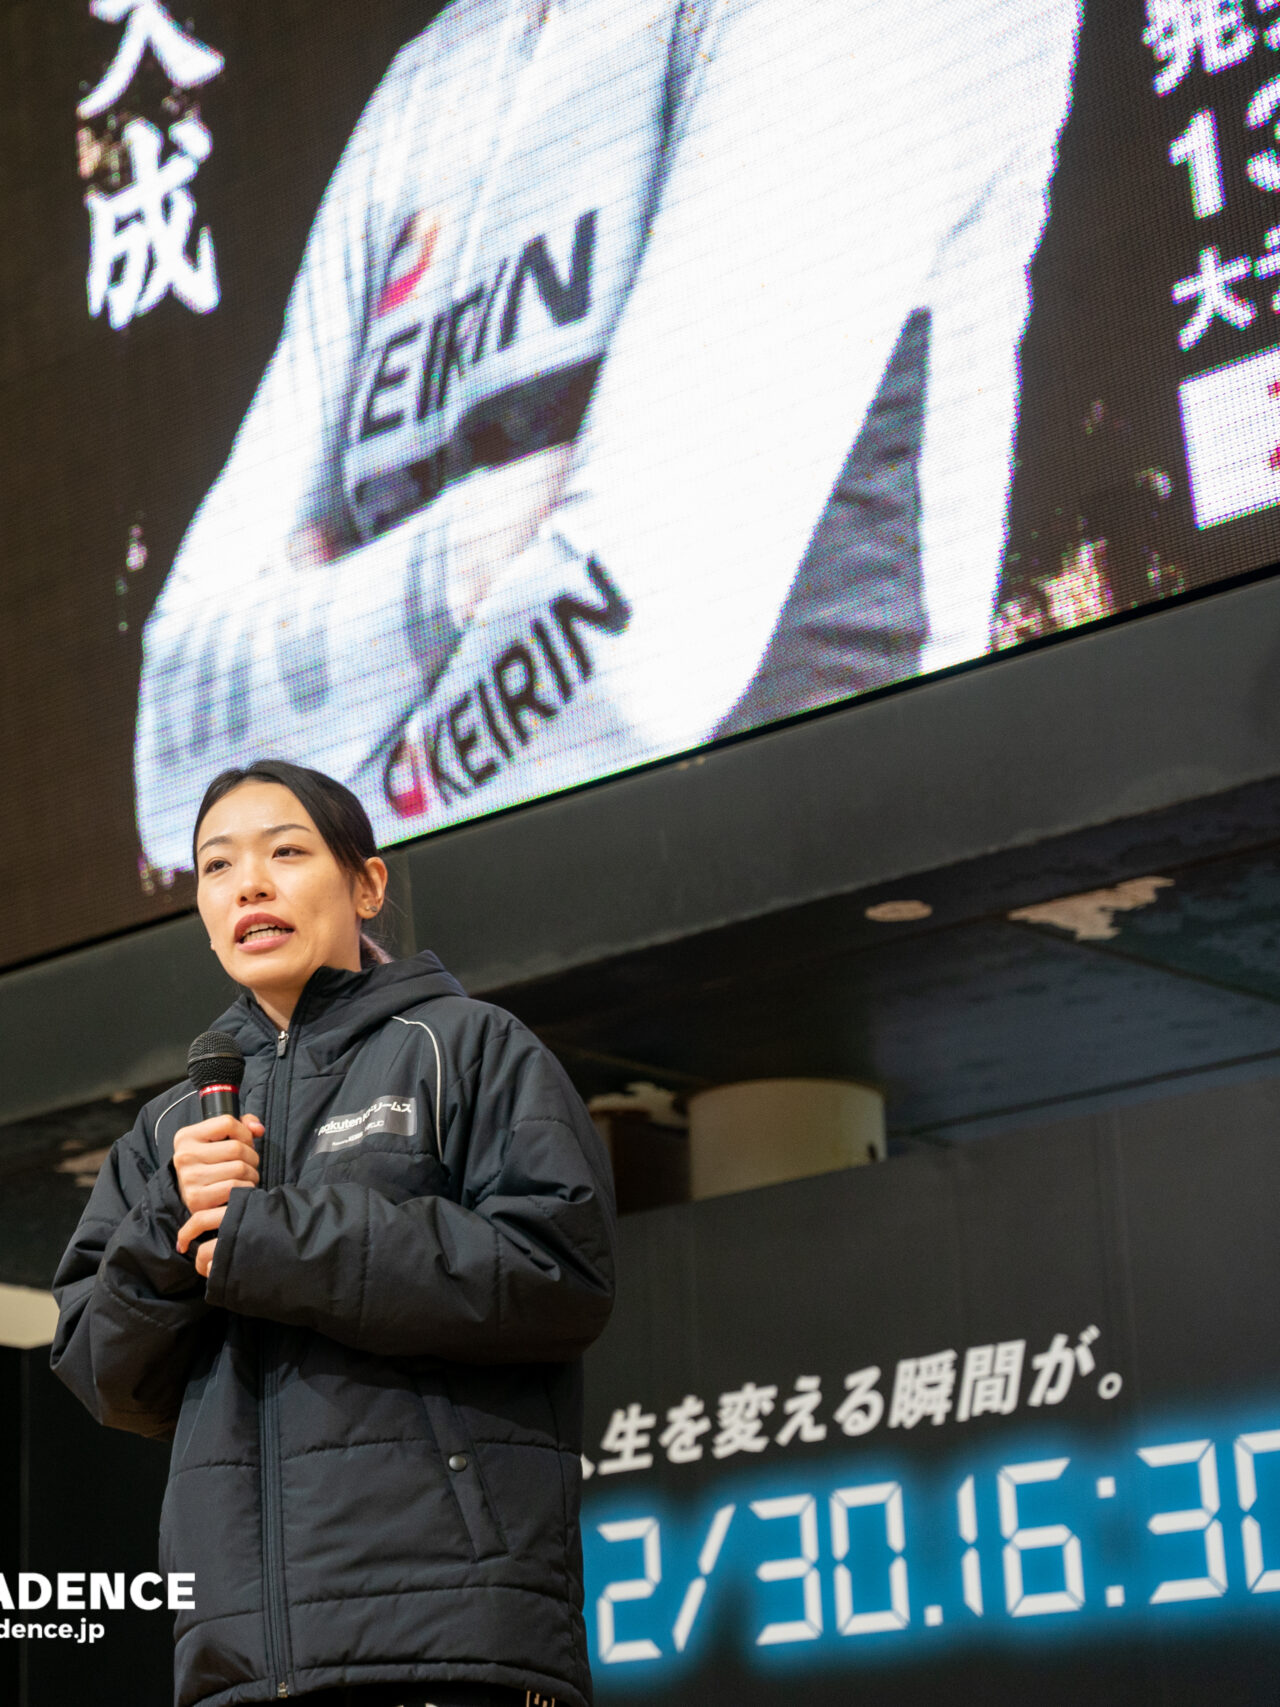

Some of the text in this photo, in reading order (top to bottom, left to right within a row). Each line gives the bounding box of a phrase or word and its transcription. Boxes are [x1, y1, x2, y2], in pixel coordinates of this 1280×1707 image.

[423, 550, 632, 806] KEIRIN
[582, 1324, 1122, 1480] 生を変える瞬間が。
